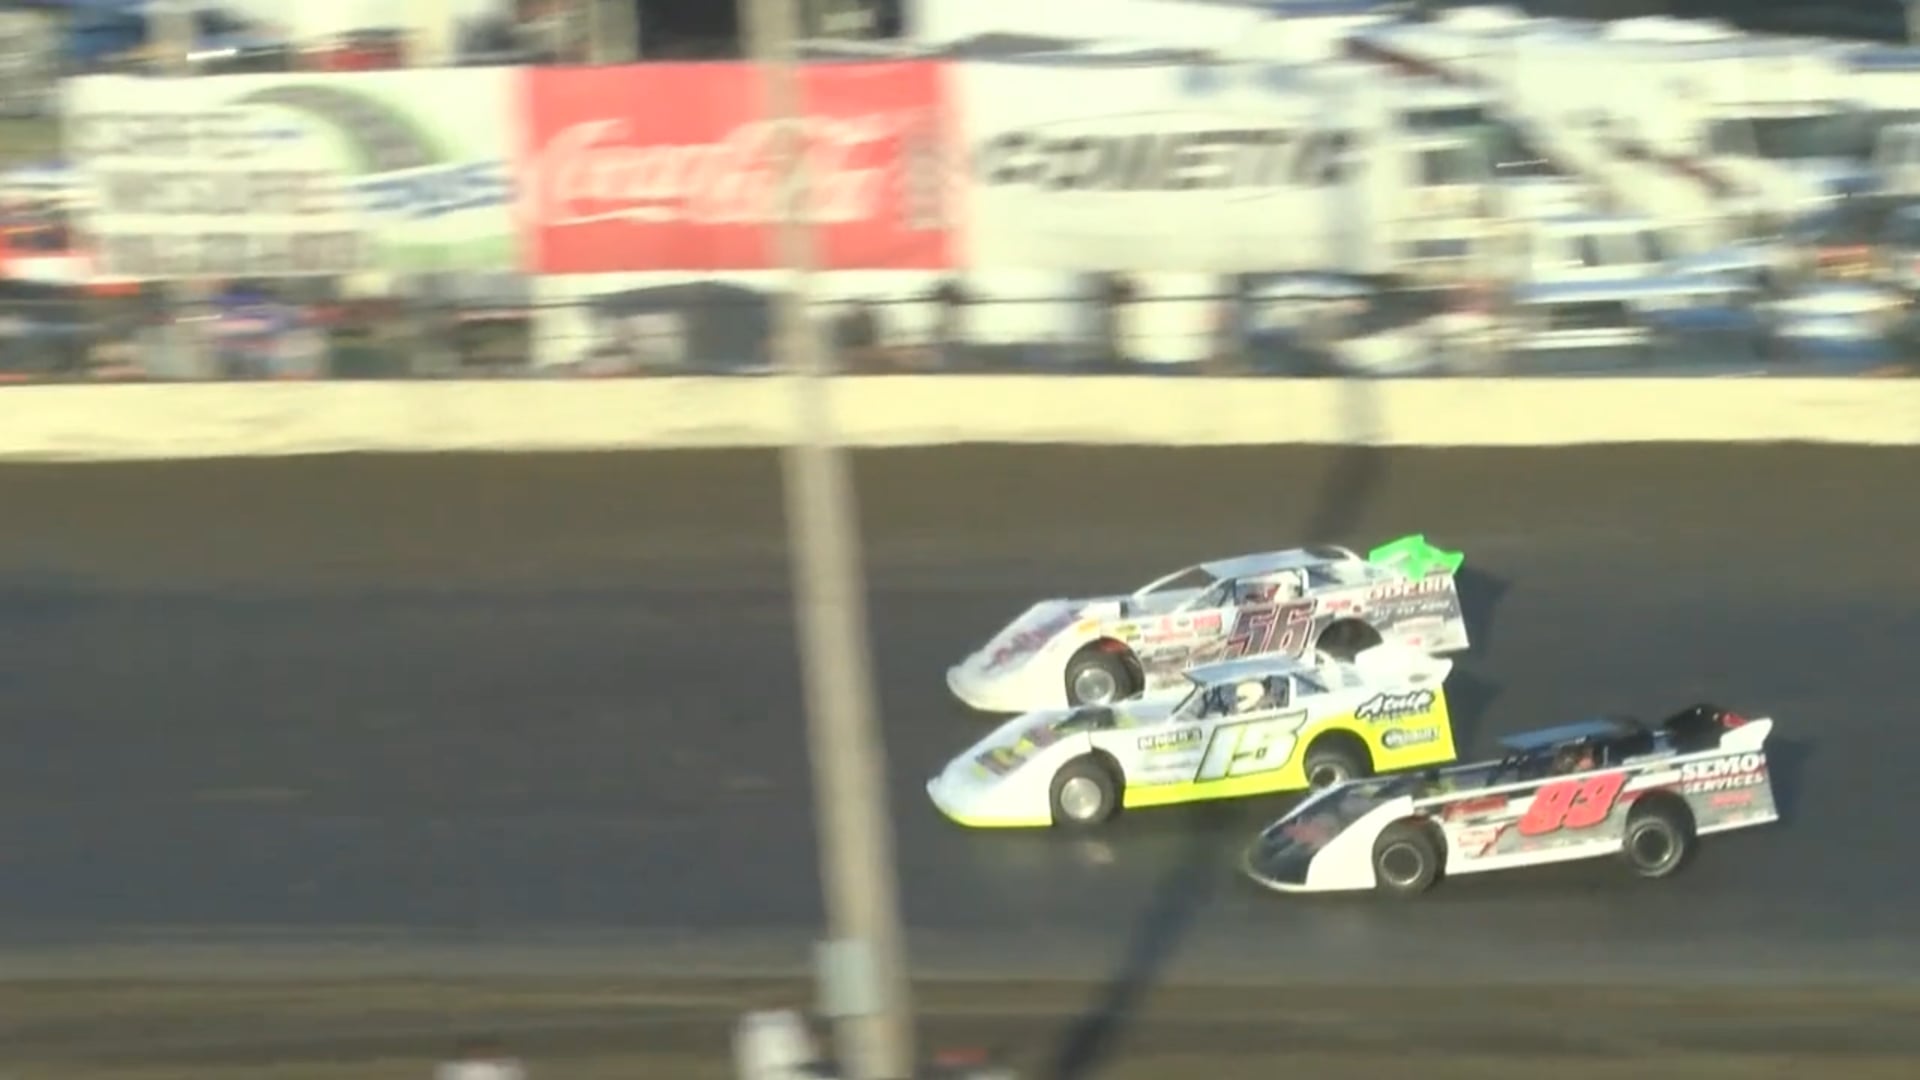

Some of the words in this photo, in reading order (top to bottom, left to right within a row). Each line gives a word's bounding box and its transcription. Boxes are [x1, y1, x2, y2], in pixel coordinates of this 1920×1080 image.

[1226, 599, 1319, 660] 56
[1193, 708, 1308, 784] 15
[1681, 753, 1761, 783] SEMO
[1682, 772, 1765, 795] SERVICES
